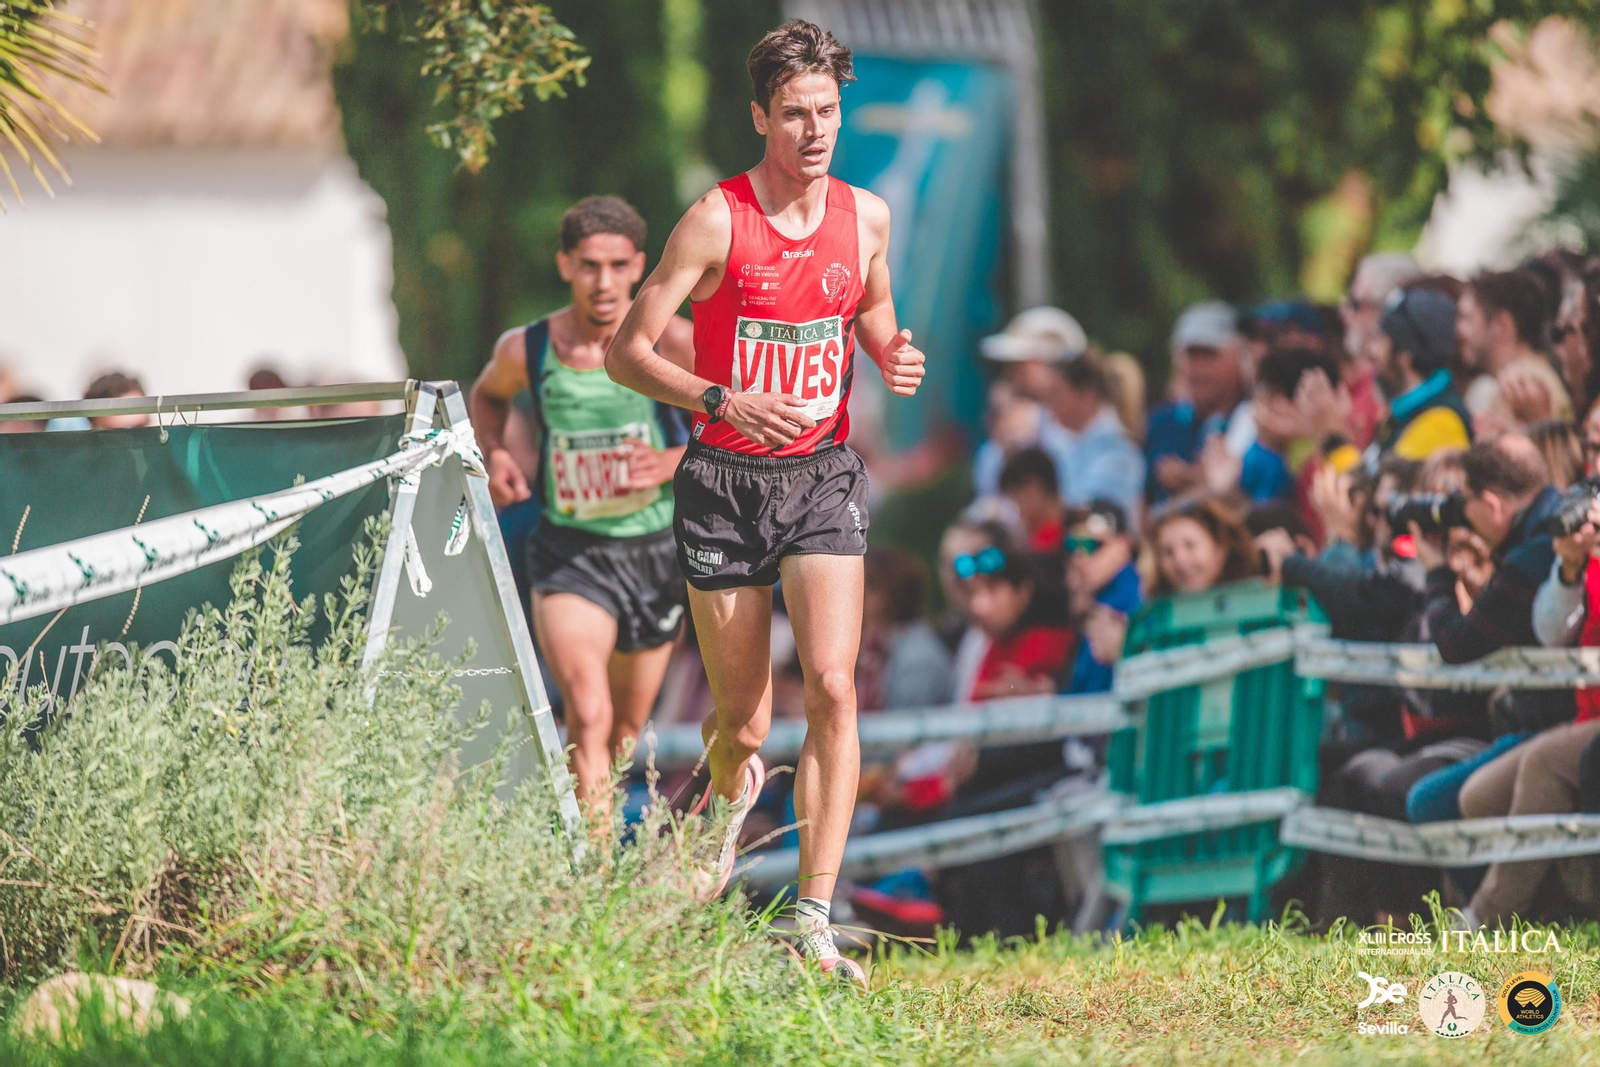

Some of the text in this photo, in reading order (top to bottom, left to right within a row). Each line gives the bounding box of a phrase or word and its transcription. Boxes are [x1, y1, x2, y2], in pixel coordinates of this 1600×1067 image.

[769, 325, 819, 341] ITÁLICA
[737, 338, 840, 401] VIVES
[696, 550, 724, 565] CAMÍ
